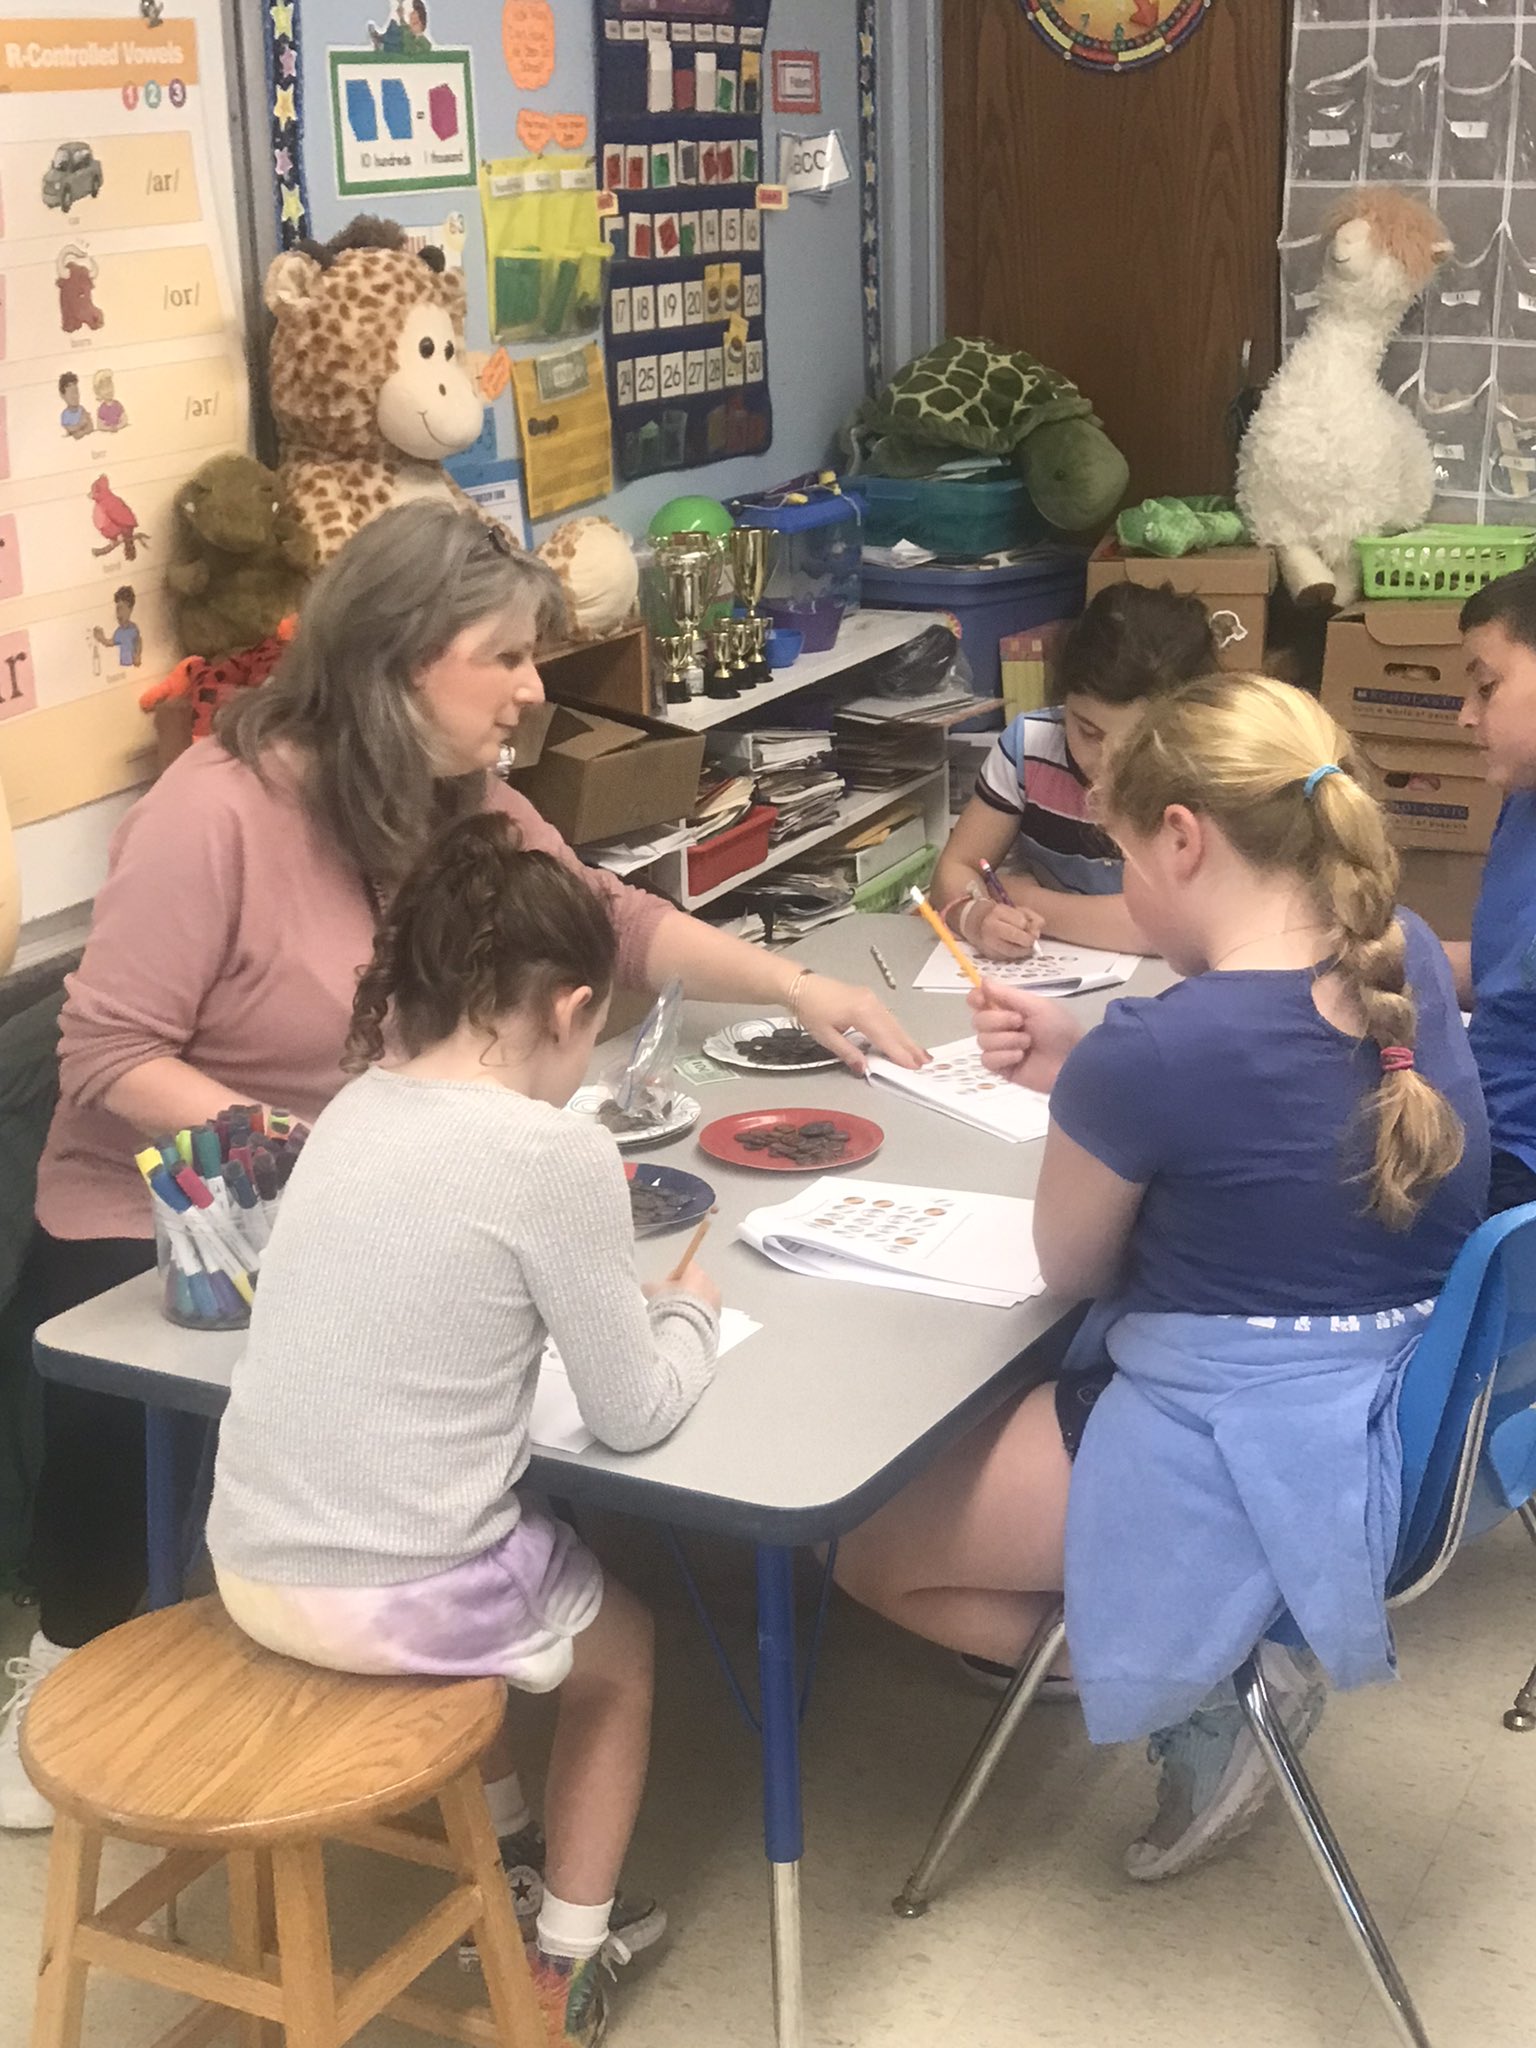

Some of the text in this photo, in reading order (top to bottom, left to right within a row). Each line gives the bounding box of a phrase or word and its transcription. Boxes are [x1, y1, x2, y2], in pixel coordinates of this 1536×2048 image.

[5, 41, 185, 69] R-Controlled Vowels
[725, 217, 737, 242] 15
[615, 283, 760, 324] 17 18 19 20 23
[618, 350, 761, 396] 24 25 26 27 28 30
